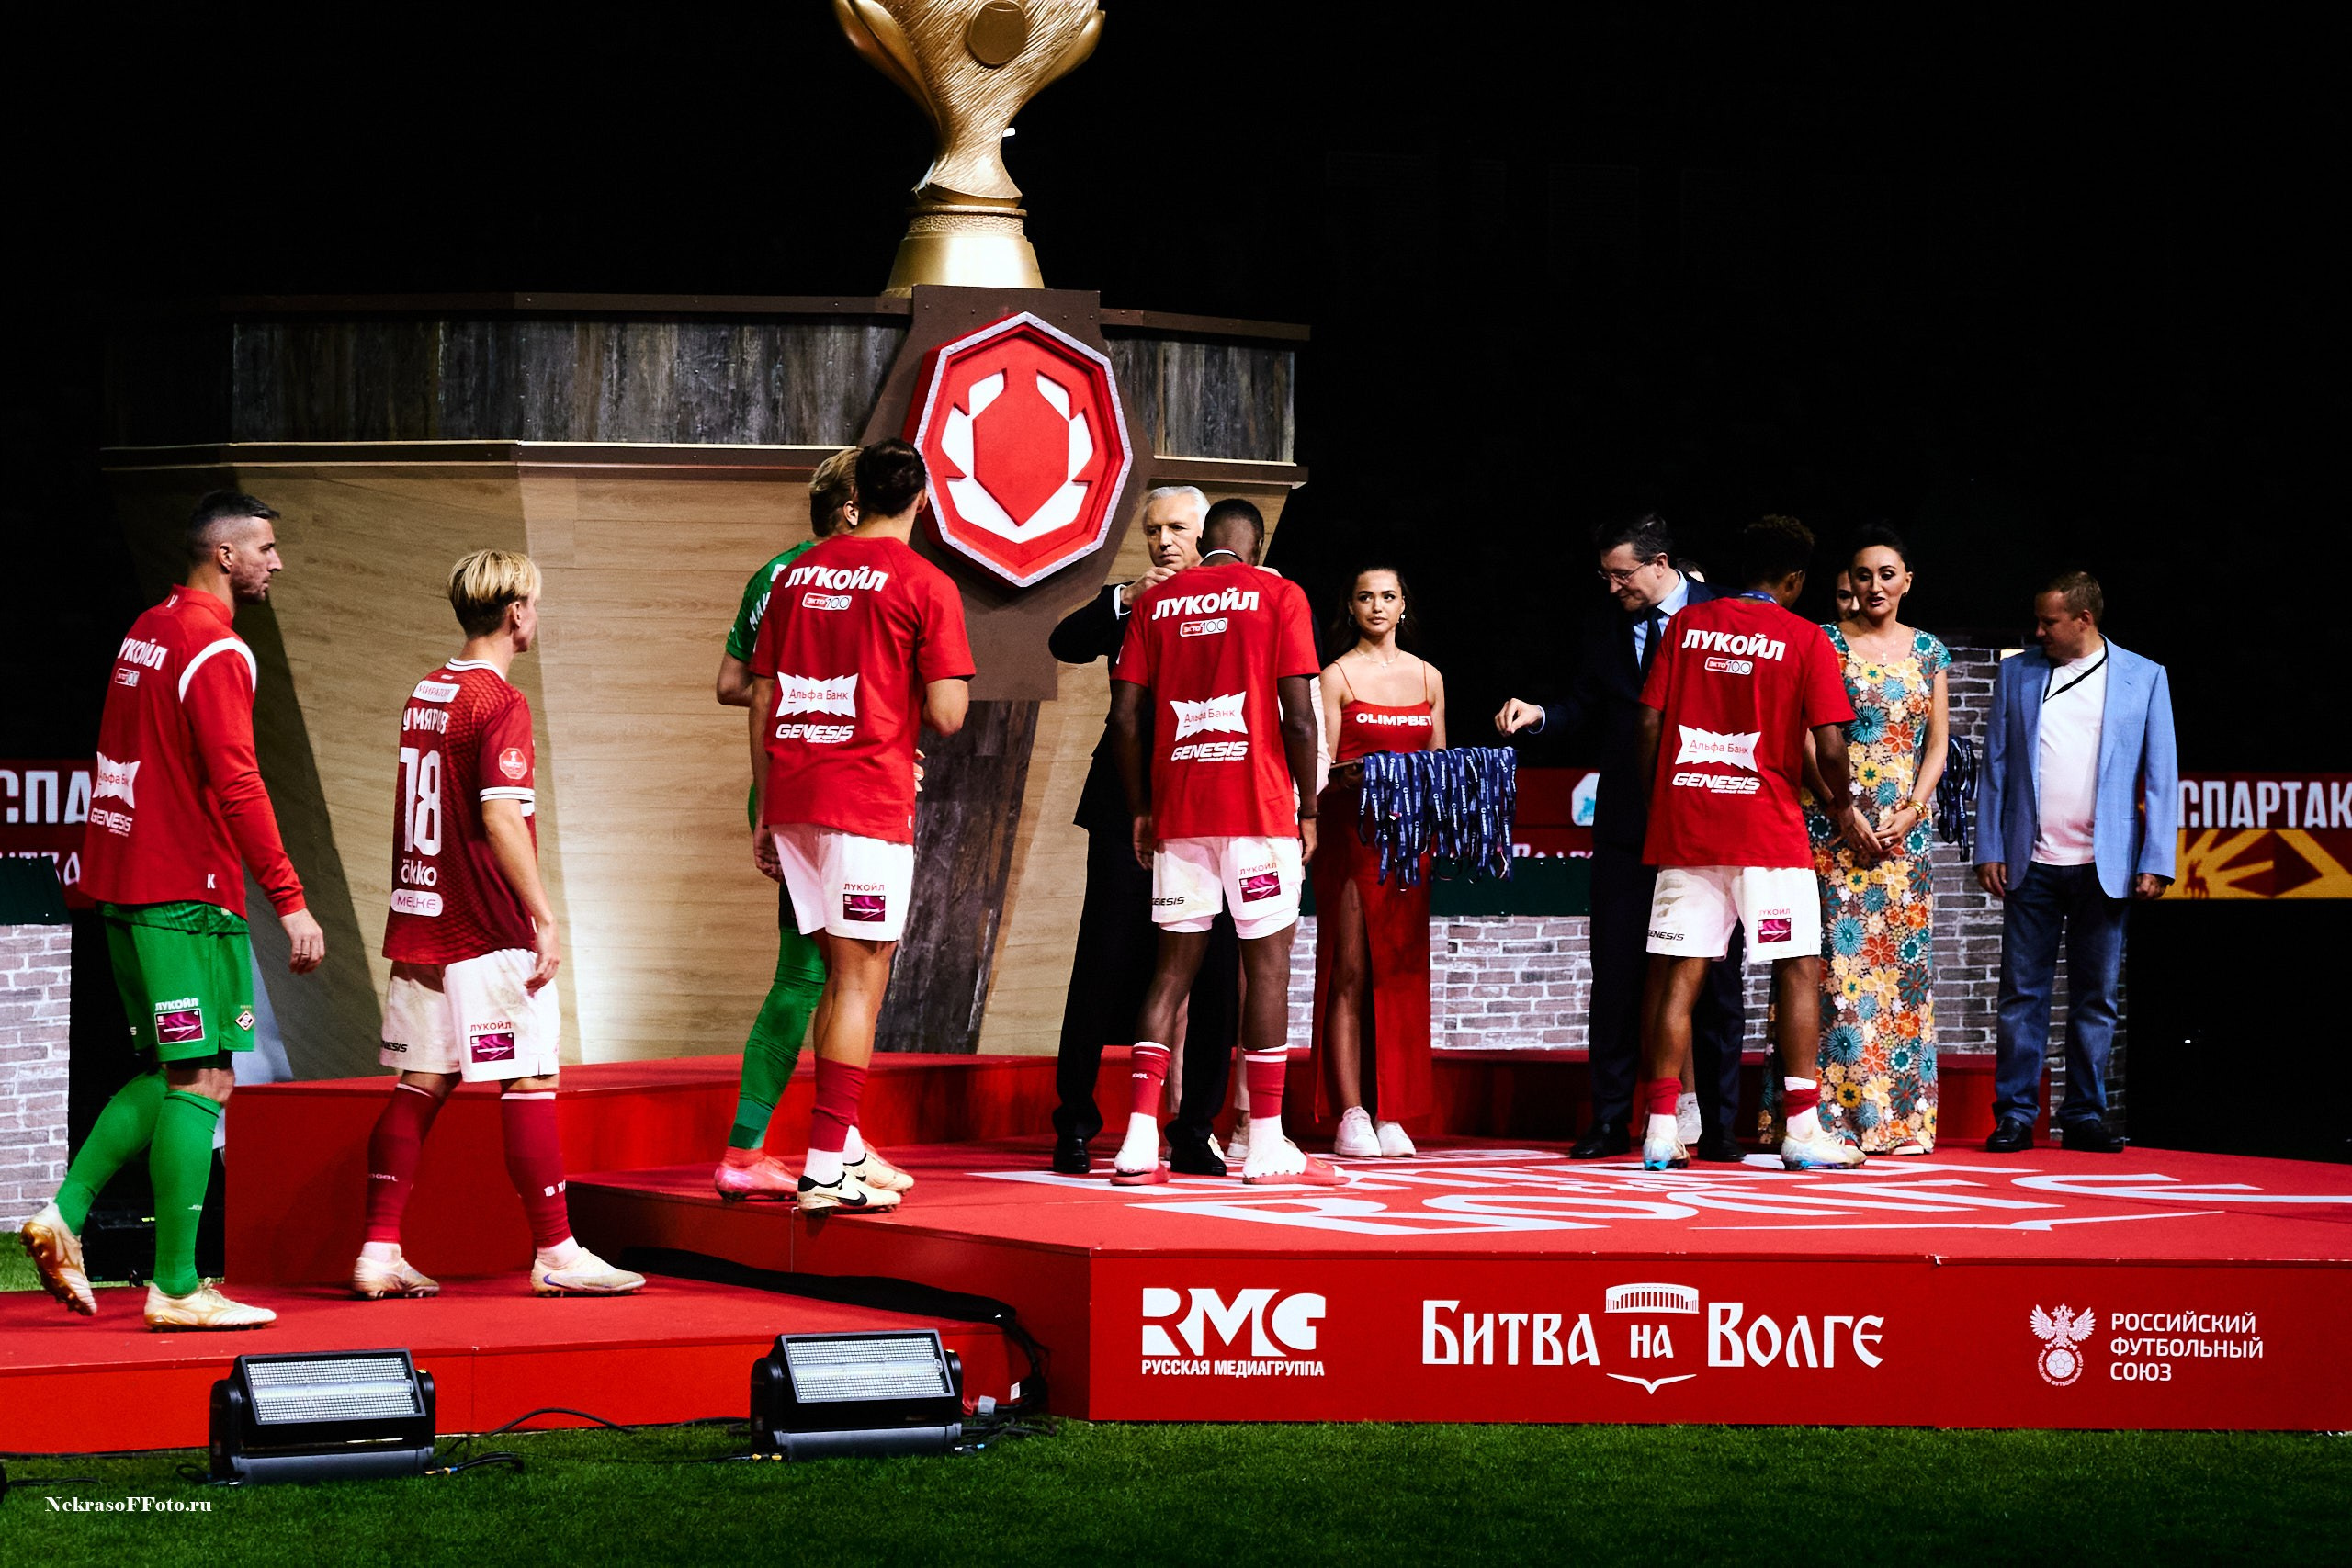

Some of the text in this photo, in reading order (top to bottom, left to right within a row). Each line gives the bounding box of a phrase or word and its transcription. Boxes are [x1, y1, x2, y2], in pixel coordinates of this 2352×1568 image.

[784, 565, 888, 592] ЛУКОЙЛ
[1151, 587, 1260, 620] ЛУКОЙЛ
[117, 637, 169, 671] УКОЙЛ
[1681, 628, 1786, 662] ЛУКОЙЛ
[788, 688, 849, 704] Альфа Банк
[1208, 708, 1236, 718] Банк
[1356, 712, 1432, 727] OLIMPBET
[775, 724, 855, 739] GENESIS
[1170, 741, 1249, 761] GENESIS
[1689, 739, 1749, 754] Альфа Банк
[1672, 772, 1761, 791] GENESIS
[399, 747, 441, 856] 18
[2177, 779, 2352, 829] СПАРТАК
[1239, 862, 1277, 875] ЛУКОЙЛ
[843, 882, 885, 891] ЛУКОЙЛ
[397, 895, 436, 910] MELKE
[154, 998, 199, 1011] ЛУКОЙЛ
[469, 1021, 512, 1032] ЛУКОЙЛ
[1142, 1287, 1326, 1357] RMG
[2111, 1310, 2256, 1334] РОССИЙСКИЙ
[2110, 1337, 2264, 1359] ФУТБОЛЬНЫЙ
[1141, 1359, 1326, 1378] РУССКАЯ МЕДИАГРУППА
[2110, 1362, 2172, 1382] СОЮЗ
